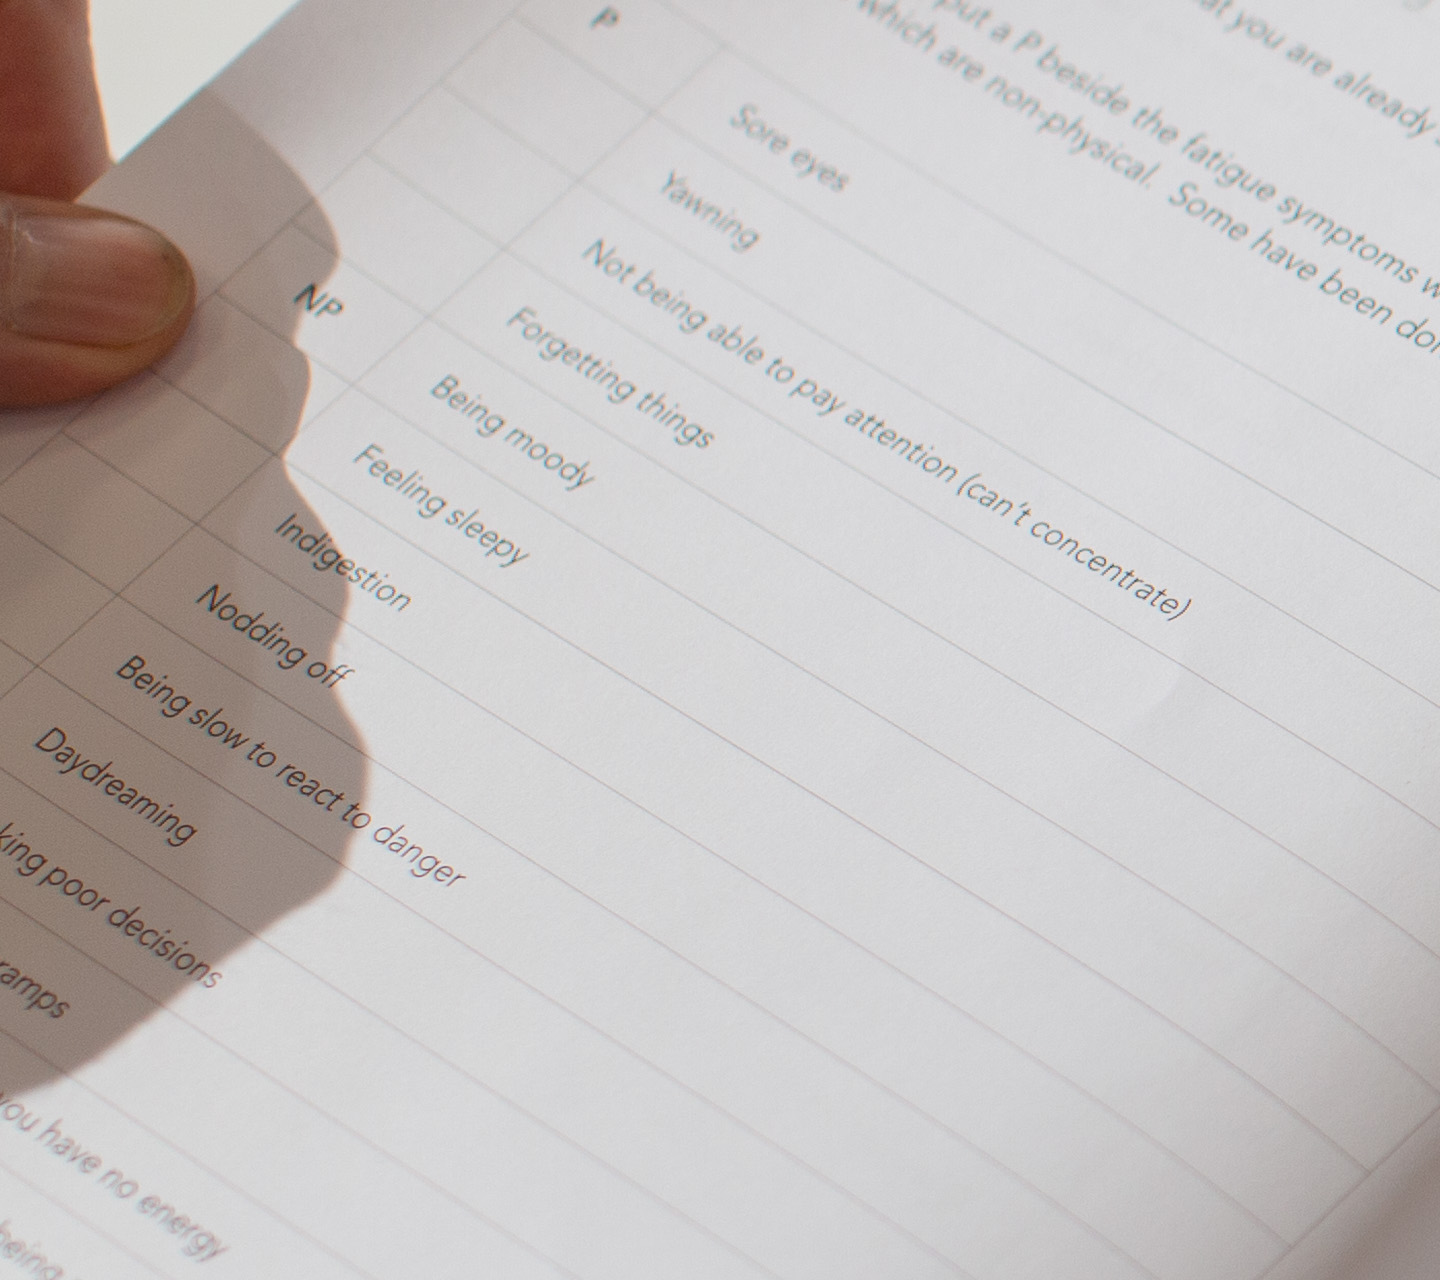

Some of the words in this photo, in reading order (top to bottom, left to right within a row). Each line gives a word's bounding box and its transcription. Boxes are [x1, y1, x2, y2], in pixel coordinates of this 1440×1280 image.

[589, 6, 620, 29] P
[1223, 10, 1287, 51] you
[1285, 43, 1333, 77] are
[1333, 72, 1437, 139] already
[729, 102, 790, 155] Sore
[790, 149, 850, 193] eyes
[660, 169, 761, 254] Yawning
[1167, 181, 1250, 242] Some
[1250, 228, 1319, 282] have
[1318, 267, 1394, 325] been
[1276, 196, 1420, 284] symptoms
[293, 282, 345, 318] NP
[430, 373, 507, 439] Being
[503, 427, 596, 492] moody
[506, 305, 638, 405] Forgetting
[635, 391, 715, 450] things
[581, 237, 637, 285] Not
[631, 269, 709, 335] being
[706, 324, 765, 365] able
[764, 356, 796, 384] to
[788, 378, 847, 417] pay
[843, 408, 959, 484] attention
[1029, 521, 1193, 622] concentrate)
[274, 512, 412, 613] Indigestion
[352, 443, 449, 520] Feeling
[444, 509, 530, 569] sleepy
[194, 583, 309, 671] Nodding
[305, 661, 356, 688] off
[33, 726, 198, 848] Daydreaming
[114, 654, 193, 719] Being
[187, 707, 251, 750] slow
[245, 741, 278, 769] to
[274, 763, 345, 812] react
[340, 802, 372, 830] to
[371, 824, 467, 887] danger
[35, 866, 112, 912] poor
[105, 906, 223, 989] decisions
[35, 1118, 103, 1174] have
[97, 1167, 140, 1200] no
[137, 1194, 229, 1263] energy
